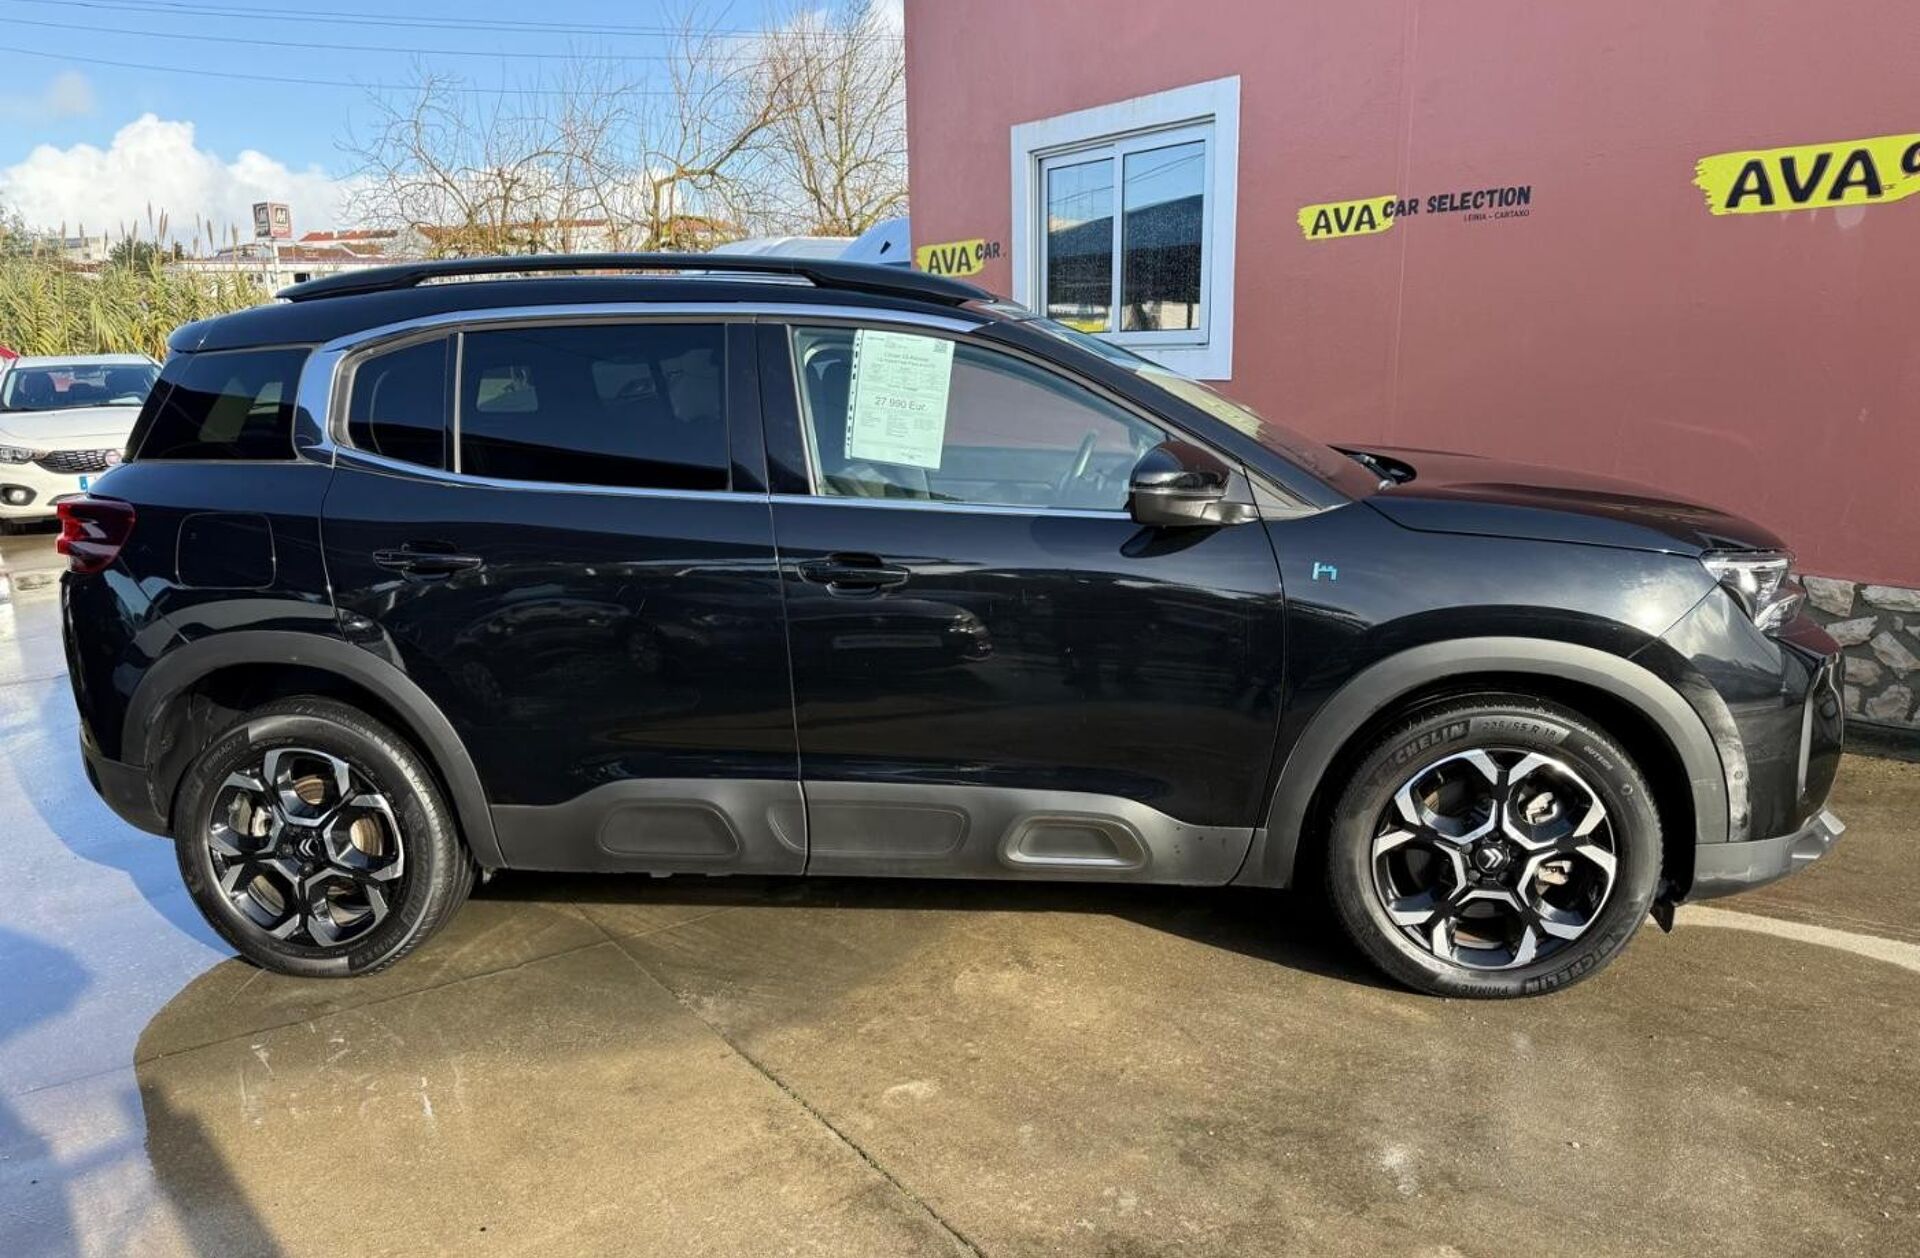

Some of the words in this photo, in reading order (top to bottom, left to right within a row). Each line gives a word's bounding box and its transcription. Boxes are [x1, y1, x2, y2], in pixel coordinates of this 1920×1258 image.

[1725, 148, 1883, 209] AVA
[1311, 204, 1377, 235] AVA
[1382, 199, 1419, 219] CAR
[1426, 186, 1532, 213] SELECTION
[928, 246, 972, 274] AVA
[975, 242, 1000, 260] CAR
